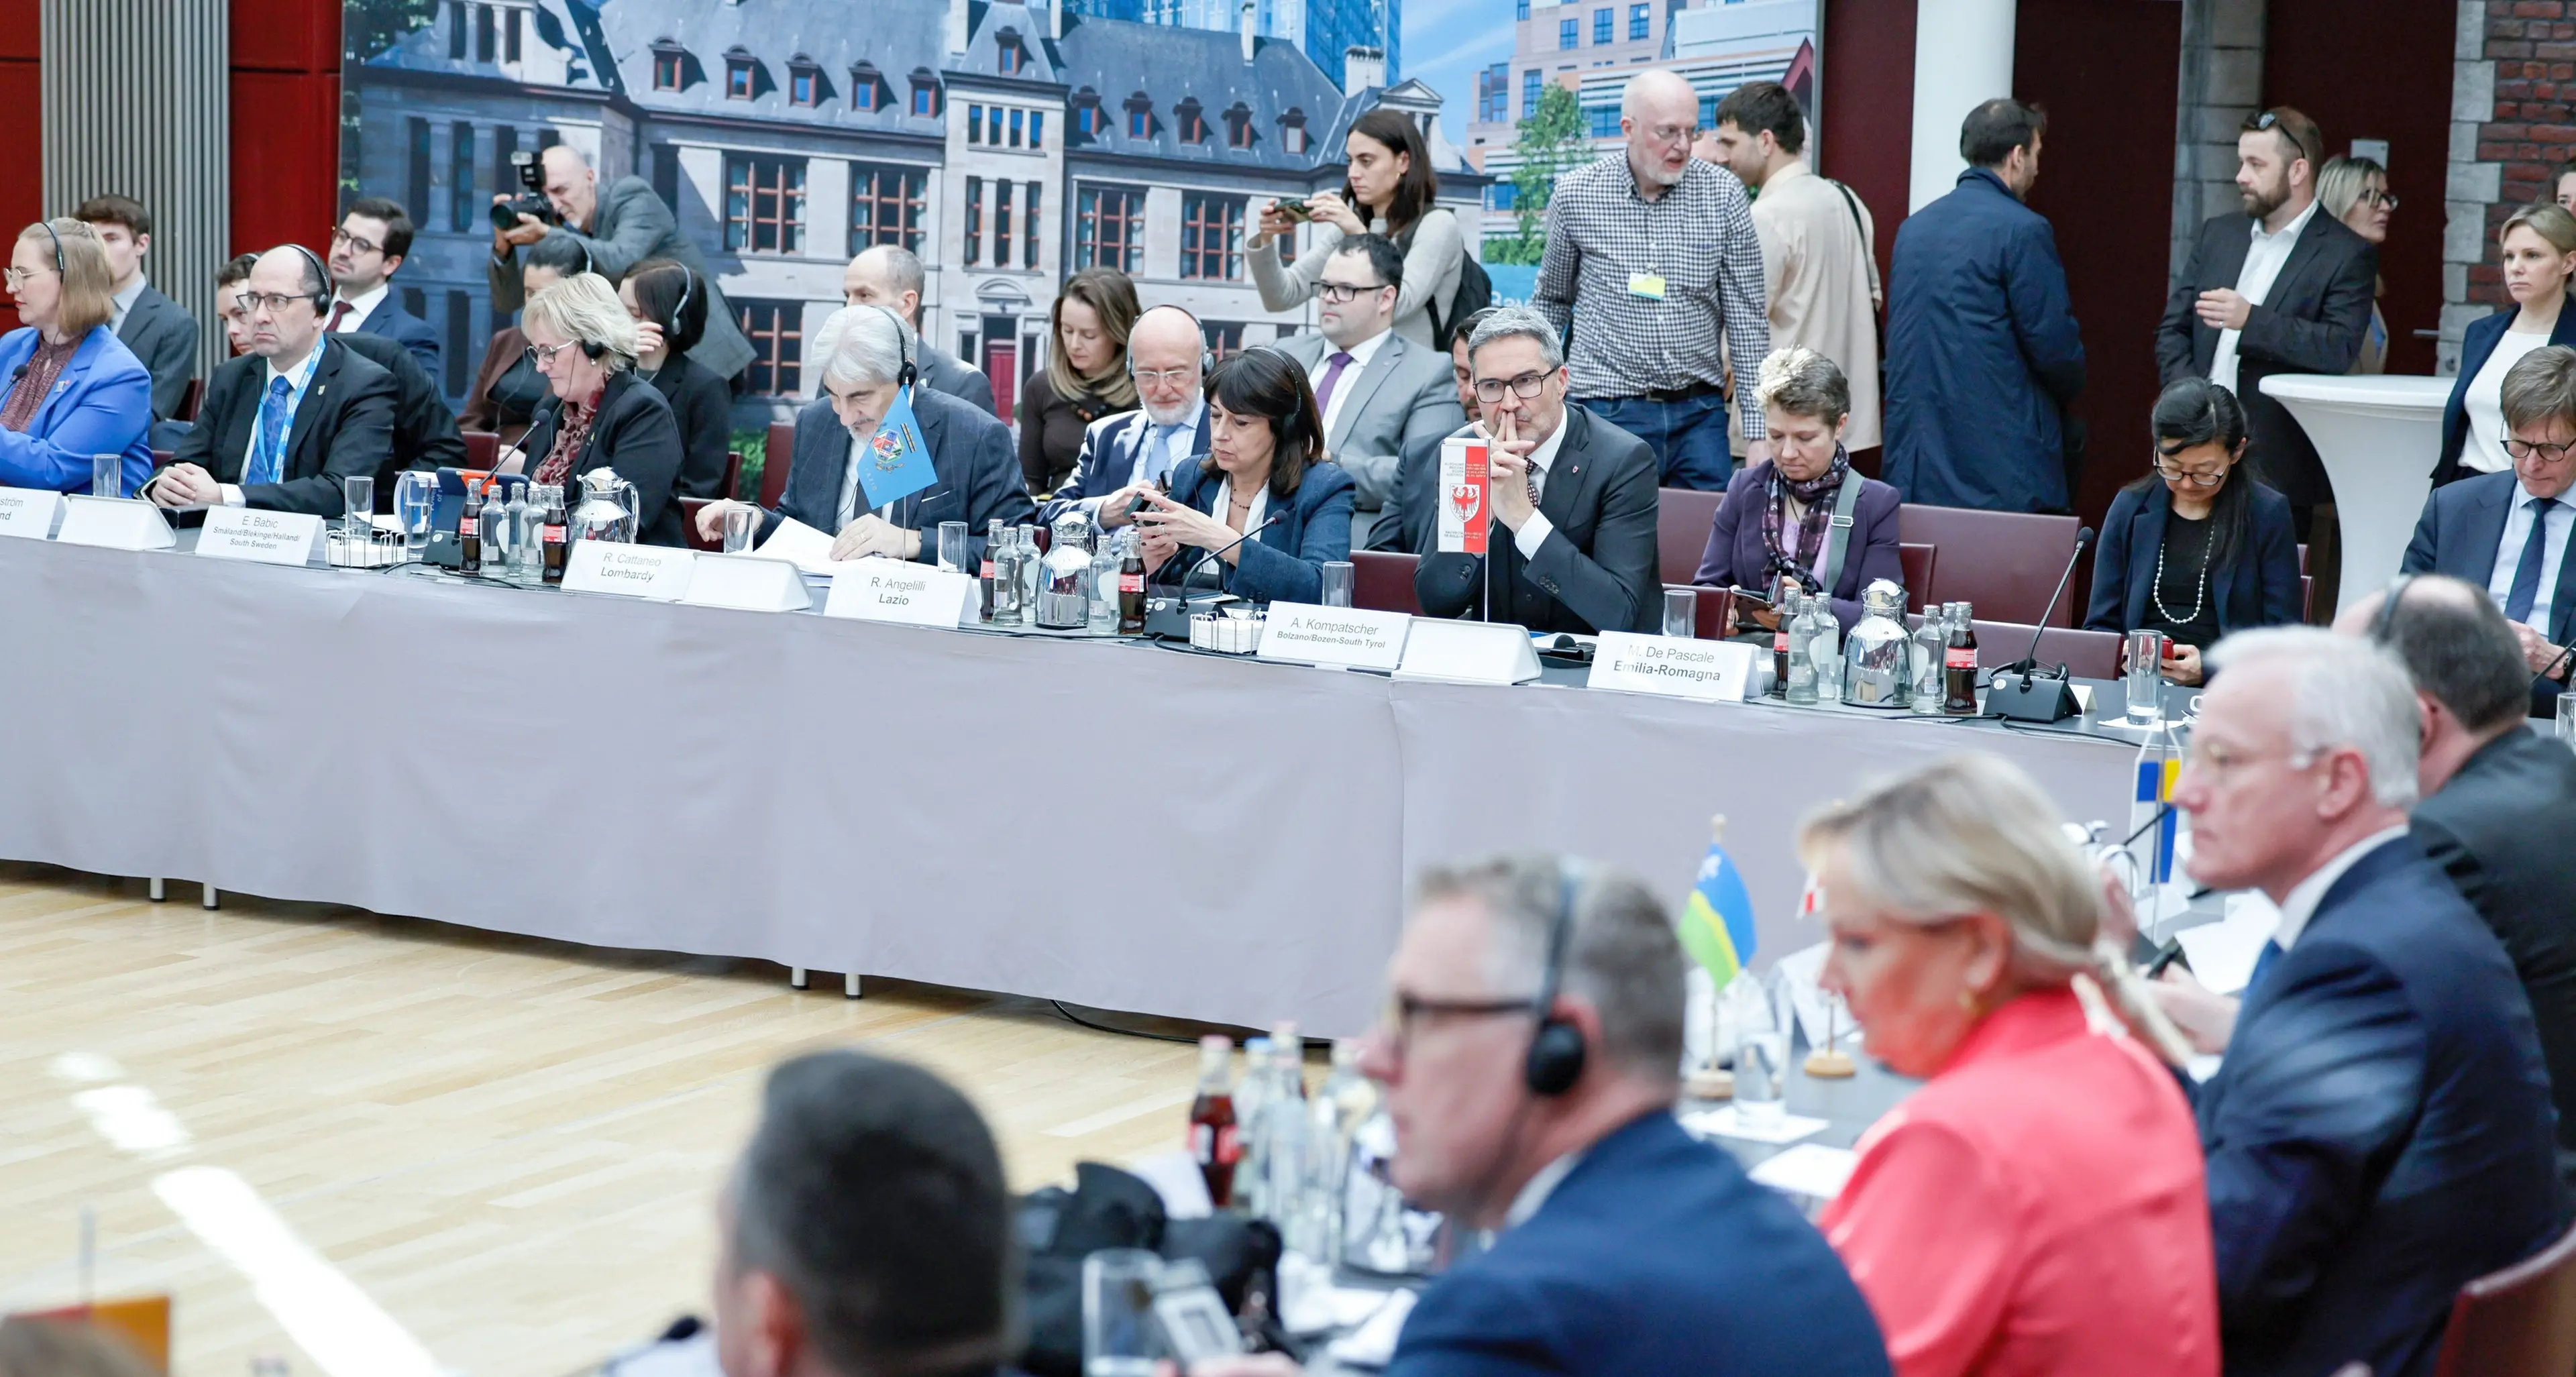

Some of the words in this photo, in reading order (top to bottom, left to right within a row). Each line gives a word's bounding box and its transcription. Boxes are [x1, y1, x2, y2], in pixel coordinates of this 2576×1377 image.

[241, 515, 251, 526] E.
[254, 516, 279, 529] Babic
[229, 538, 250, 547] South
[251, 540, 277, 550] Sweden
[603, 552, 613, 562] R.
[617, 553, 661, 567] Cattaneo
[600, 566, 655, 583] Lombardy
[871, 577, 881, 588] R.
[884, 577, 926, 592] Angelilli
[879, 593, 909, 605] Lazio
[1290, 617, 1301, 628] A.
[1306, 618, 1379, 635] Kompatscher
[1277, 630, 1362, 646] Bolzano/Bozen-South
[1365, 639, 1386, 649] Tyrol
[1627, 645, 1642, 657] M.
[1646, 646, 1664, 659] De
[1666, 648, 1715, 663] Pascale
[1613, 660, 1721, 681] Emilia-Romagna
